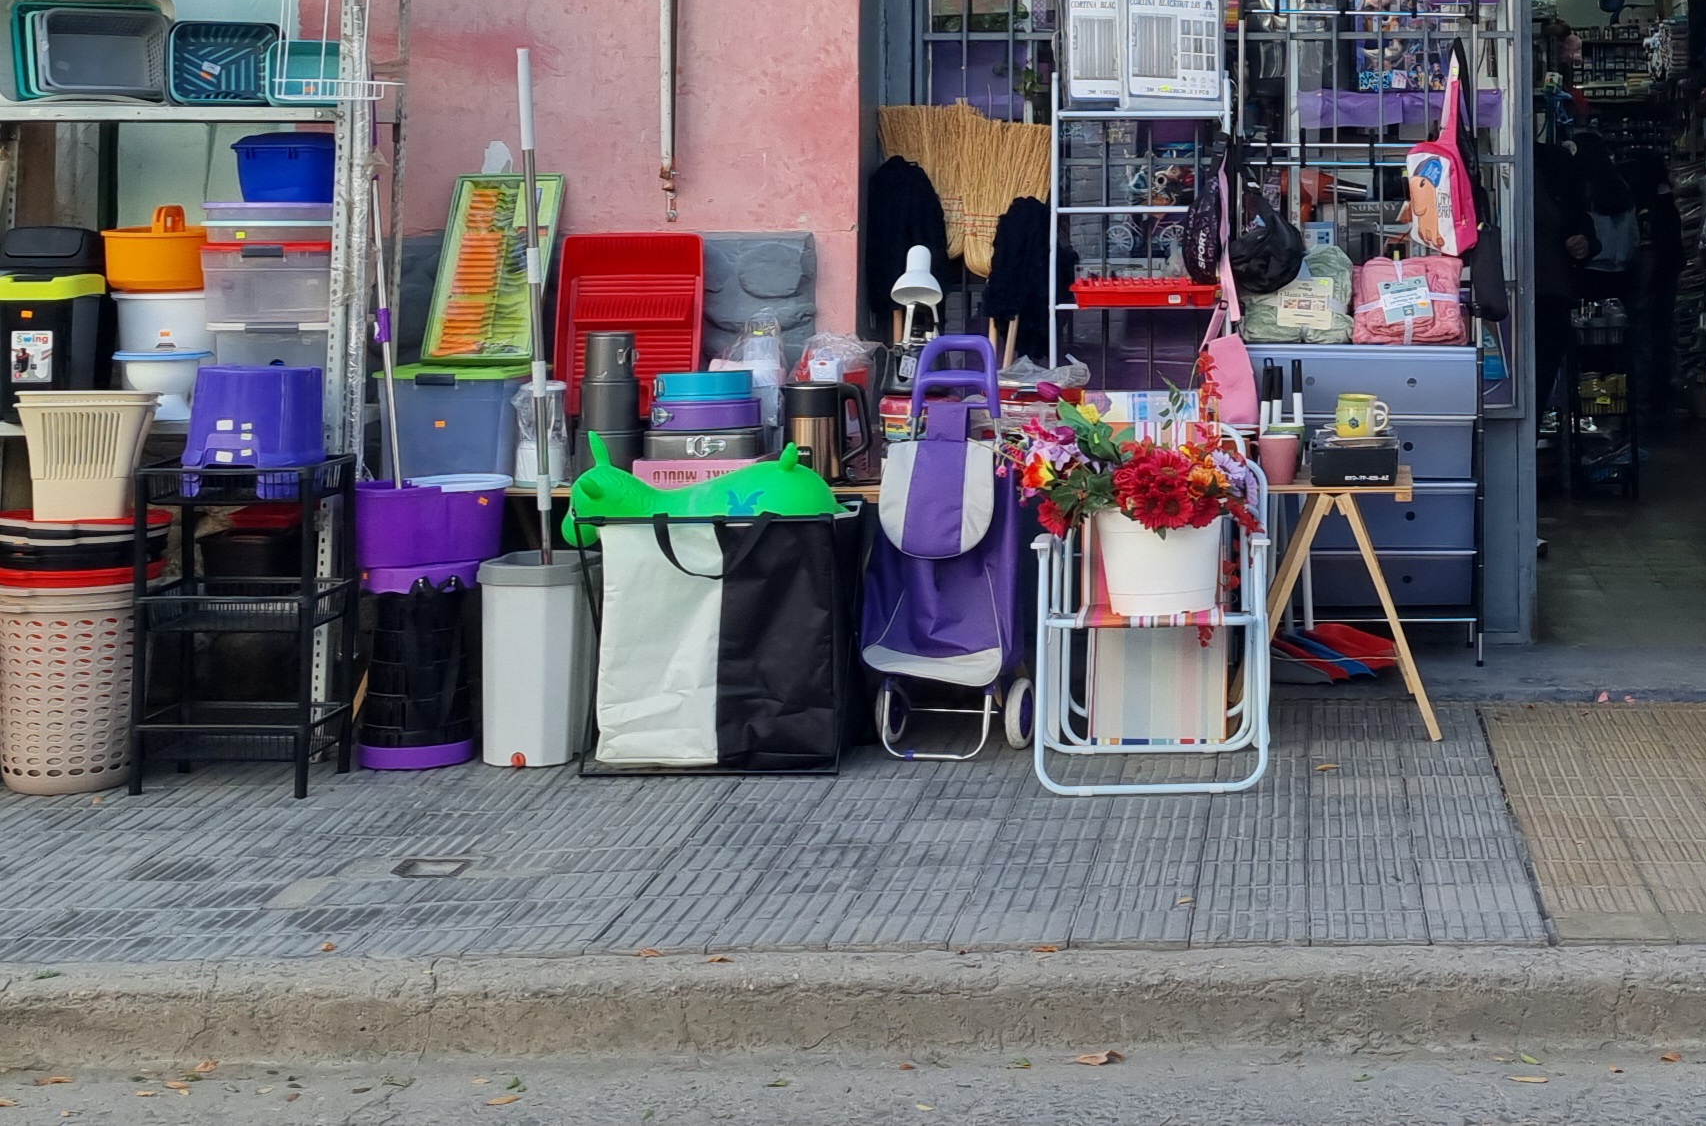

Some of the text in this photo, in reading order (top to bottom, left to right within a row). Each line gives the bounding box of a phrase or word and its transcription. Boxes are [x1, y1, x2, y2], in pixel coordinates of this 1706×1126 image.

[1070, 0, 1098, 10] CORTINA
[1197, 229, 1208, 270] SPORT
[652, 470, 698, 483] MOULD
